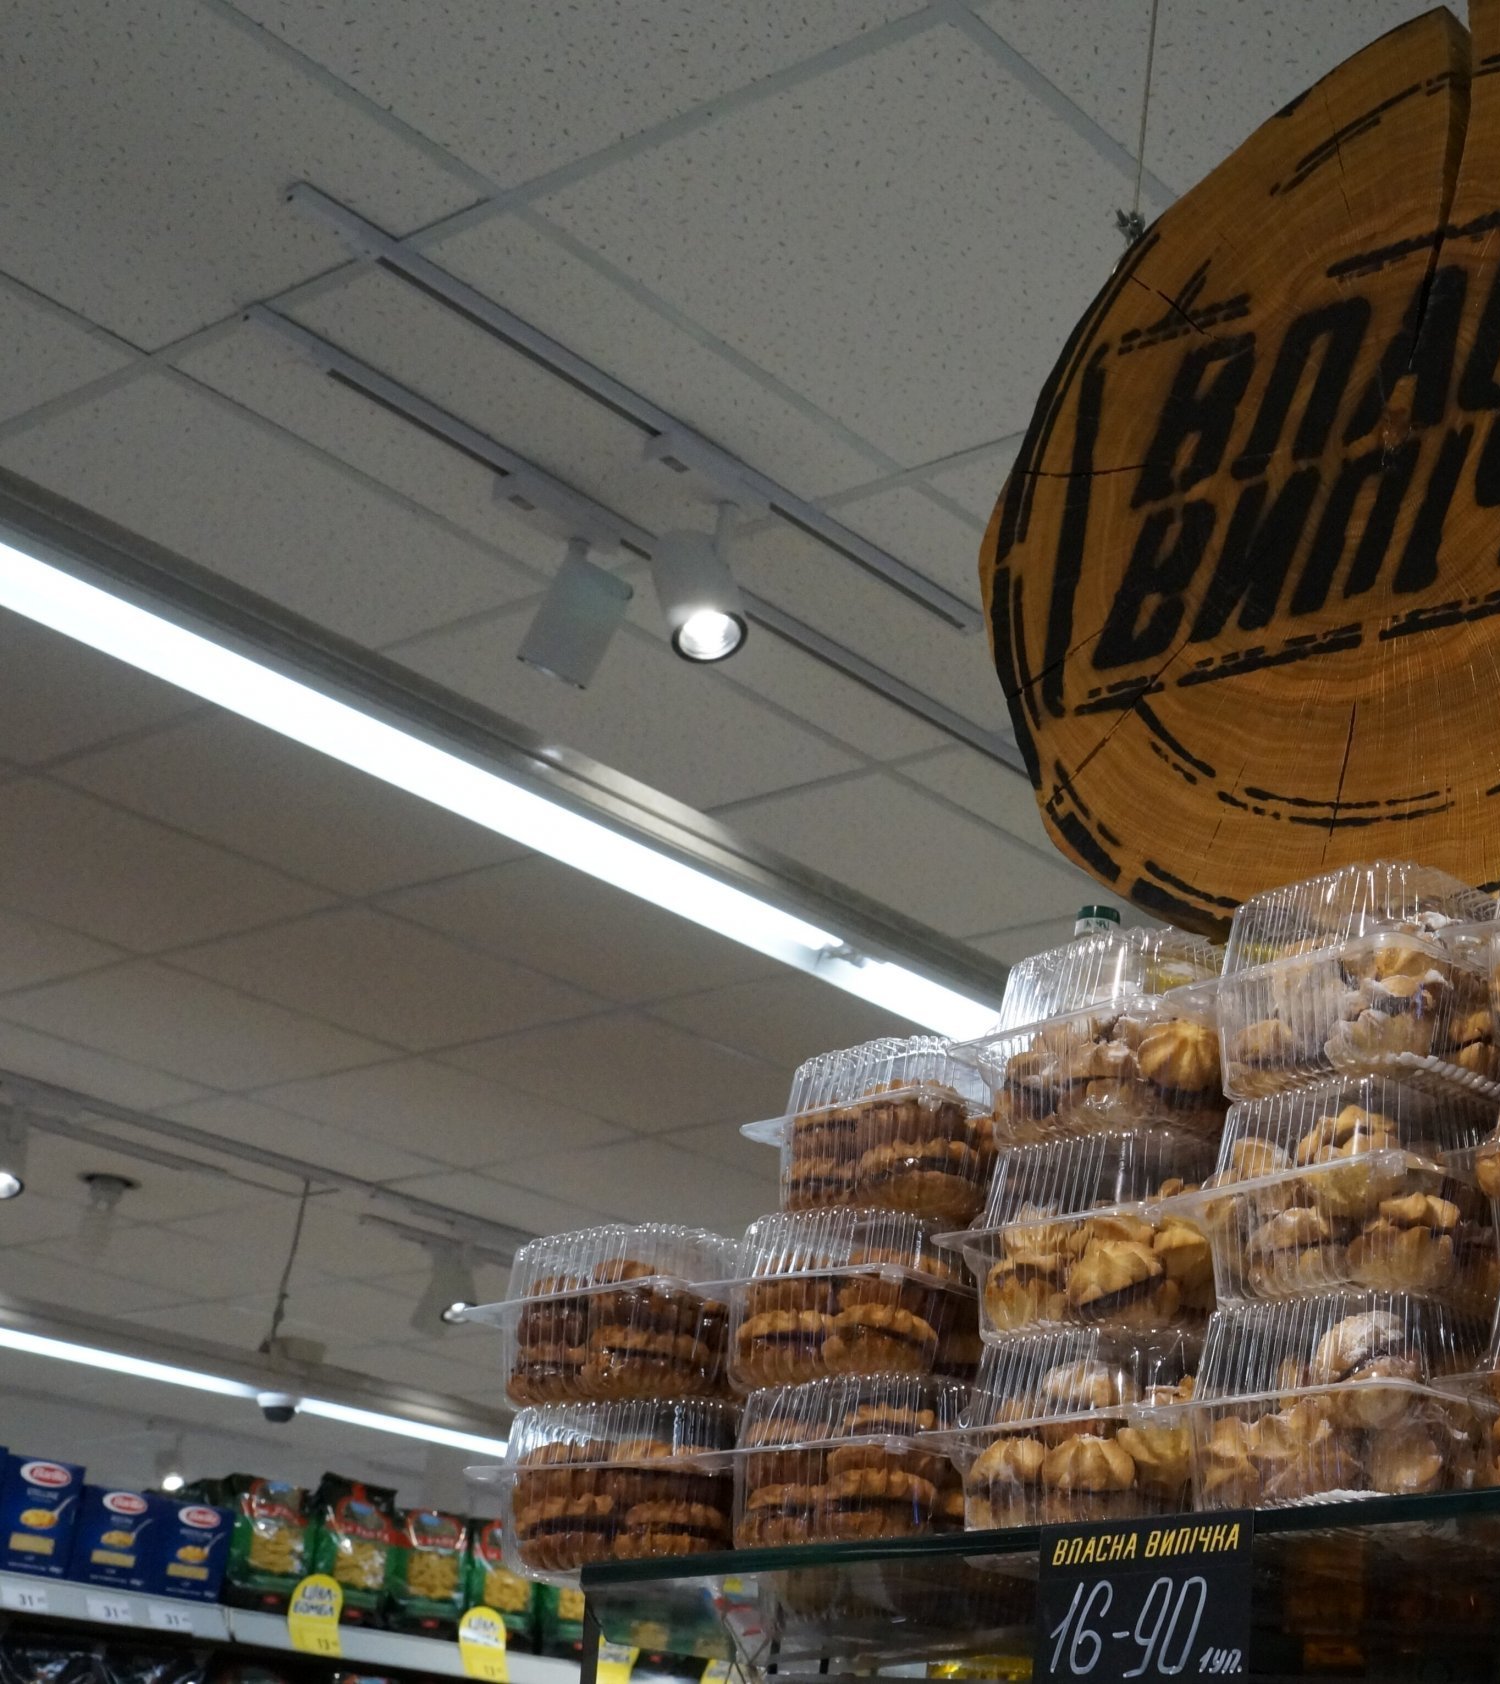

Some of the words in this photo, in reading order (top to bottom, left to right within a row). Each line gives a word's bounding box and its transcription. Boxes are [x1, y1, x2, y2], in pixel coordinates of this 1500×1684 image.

[1051, 1532, 1137, 1566] ВЛАСНА
[1144, 1523, 1240, 1558] ВИПІЧКА
[1050, 1576, 1207, 1678] 16-90
